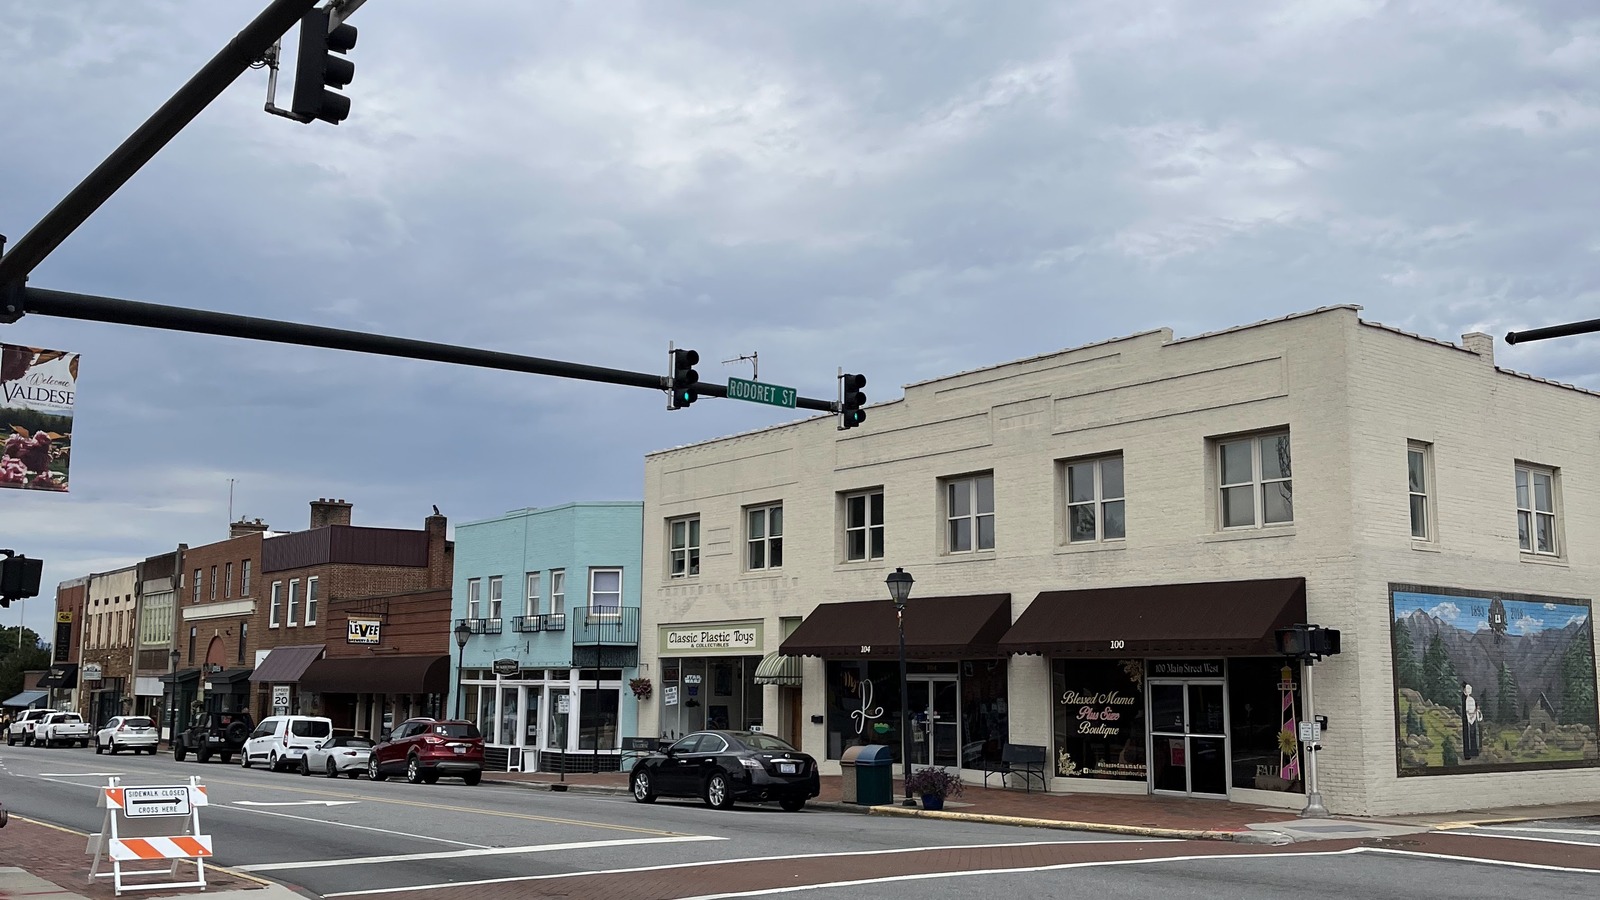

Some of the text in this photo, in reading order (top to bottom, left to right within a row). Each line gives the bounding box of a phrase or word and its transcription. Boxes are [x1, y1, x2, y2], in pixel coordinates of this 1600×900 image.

[26, 372, 70, 387] Welcome
[3, 382, 75, 405] VALDESE
[729, 380, 795, 406] RODORET ST
[350, 624, 379, 637] LEVEE
[669, 630, 754, 644] Classic Plastic Toys
[861, 645, 871, 653] 104
[1110, 640, 1125, 649] 100
[1155, 663, 1219, 673] 100 Main Street West
[274, 696, 288, 704] 20
[1061, 690, 1135, 705] Blessed Mama
[1076, 705, 1120, 720] Plus Size
[1077, 720, 1120, 739] Boutique
